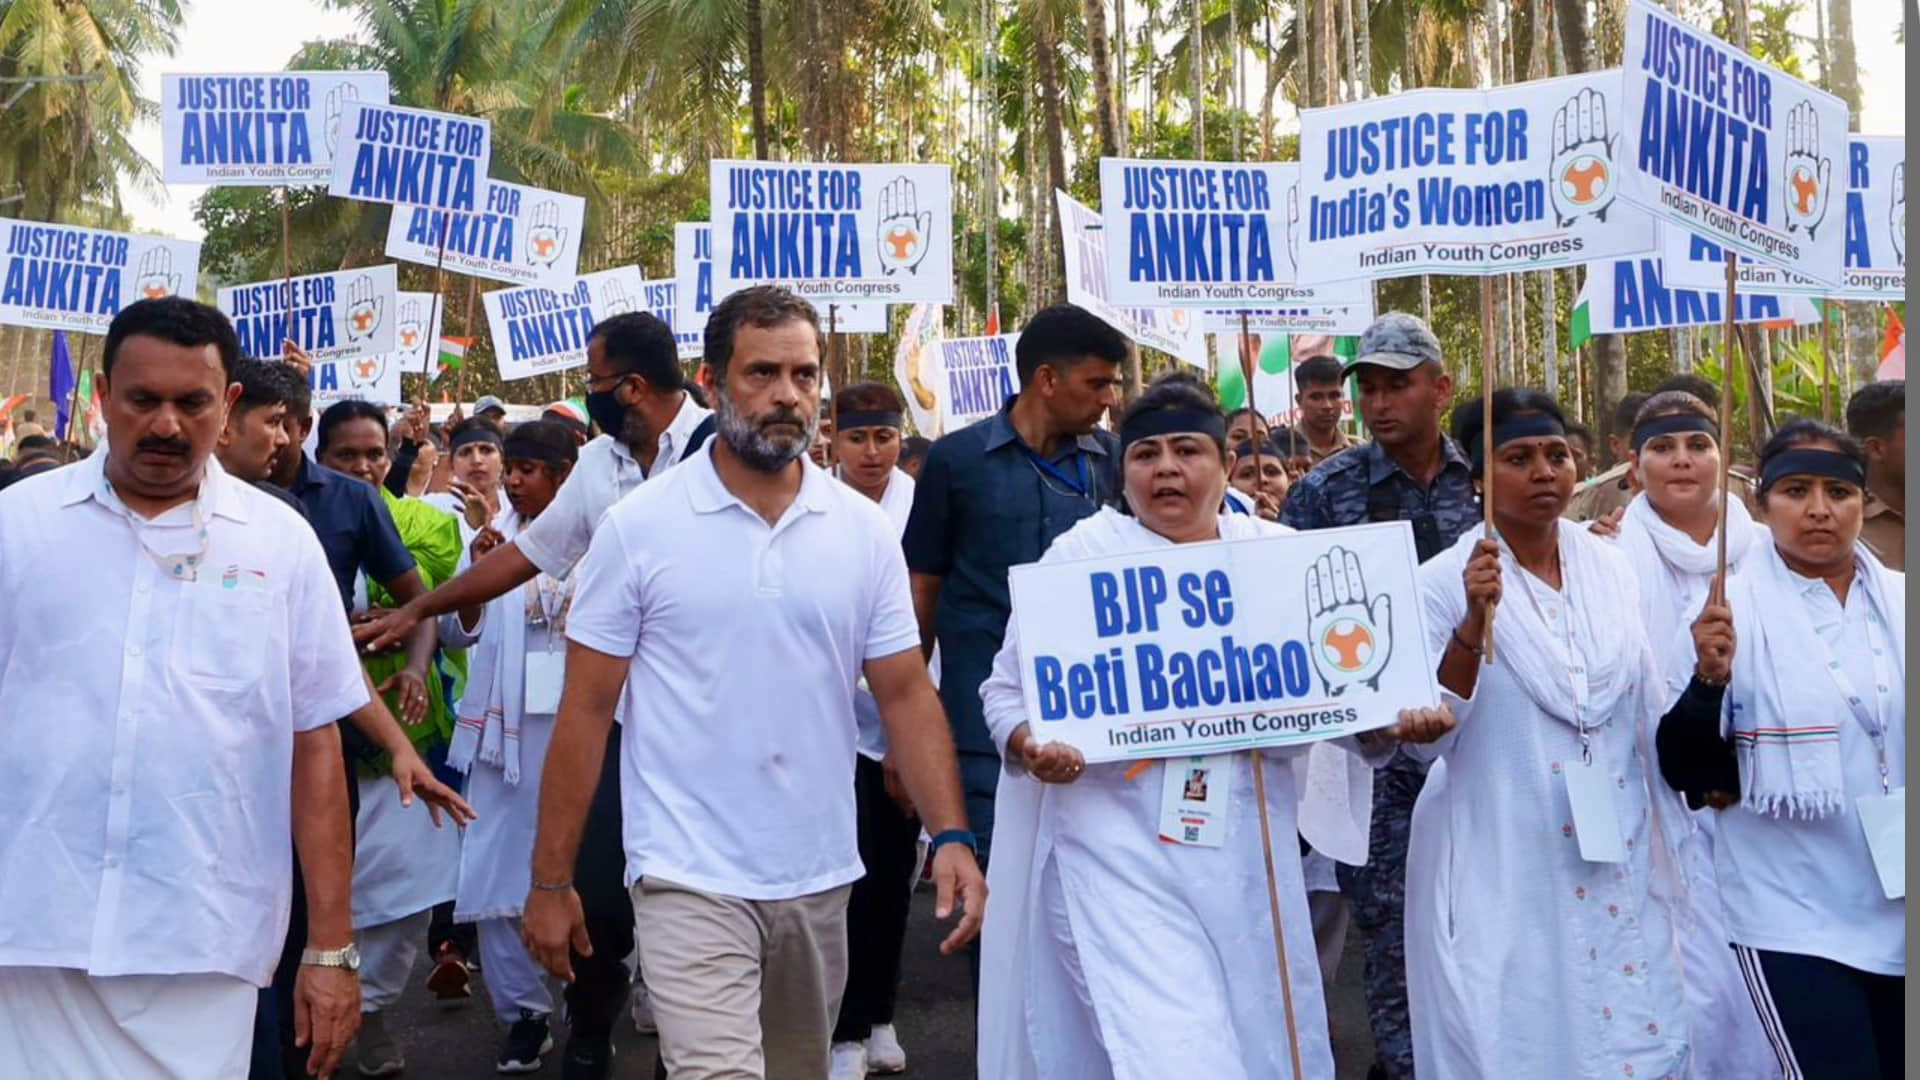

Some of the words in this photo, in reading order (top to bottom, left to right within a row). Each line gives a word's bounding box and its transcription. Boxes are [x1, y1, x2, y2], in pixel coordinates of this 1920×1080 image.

[177, 77, 265, 110] JUSTICE
[269, 77, 311, 110] FOR
[1642, 13, 1727, 109] JUSTICE
[1732, 58, 1772, 131] FOR
[180, 112, 312, 165] ANKITA
[355, 107, 442, 151] JUSTICE
[444, 120, 484, 157] FOR
[1323, 112, 1455, 181] JUSTICE
[1465, 108, 1528, 166] FOR
[1638, 77, 1769, 225] ANKITA
[206, 168, 245, 177] Indian
[249, 167, 285, 177] Youth
[287, 166, 332, 180] Congre
[350, 143, 477, 212] ANKITA
[728, 167, 813, 210] JUSTICE
[818, 170, 862, 210] FOR
[1123, 166, 1220, 210] JUSTICE
[1224, 169, 1270, 211] FOR
[487, 184, 521, 217] FOR
[1309, 183, 1411, 243] India's
[1417, 176, 1544, 227] Women
[1661, 186, 1699, 219] Indian
[1700, 199, 1738, 234] Youth
[1739, 221, 1800, 260] Congress
[7, 225, 88, 262] JUSTICE
[91, 234, 129, 266] FOR
[406, 207, 514, 263] ANKITA
[730, 212, 862, 279] ANKITA
[1129, 212, 1275, 282] ANKITA
[1359, 248, 1417, 268] Indian
[1422, 243, 1484, 262] Youth
[1489, 236, 1584, 263] Congress
[2, 257, 121, 316] ANKITA
[232, 282, 299, 317] JUSTICE
[303, 276, 335, 306] FOR
[489, 263, 538, 280] Congress
[796, 281, 831, 293] Youth
[834, 281, 901, 297] Congress
[1158, 286, 1201, 298] Indian
[1203, 285, 1243, 298] Youth
[1246, 285, 1315, 301] Congress
[500, 288, 560, 319] JUSTICE
[236, 306, 336, 358] ANKITA
[508, 307, 595, 361] ANKITA
[949, 366, 1014, 415] ANKITA
[1090, 566, 1167, 638] BJP
[1177, 569, 1235, 628] se
[1034, 647, 1129, 721] Beti
[1135, 636, 1311, 711] Bachao
[1108, 724, 1176, 747] Indian
[1181, 718, 1246, 739] Youth
[1252, 706, 1358, 736] Congress
